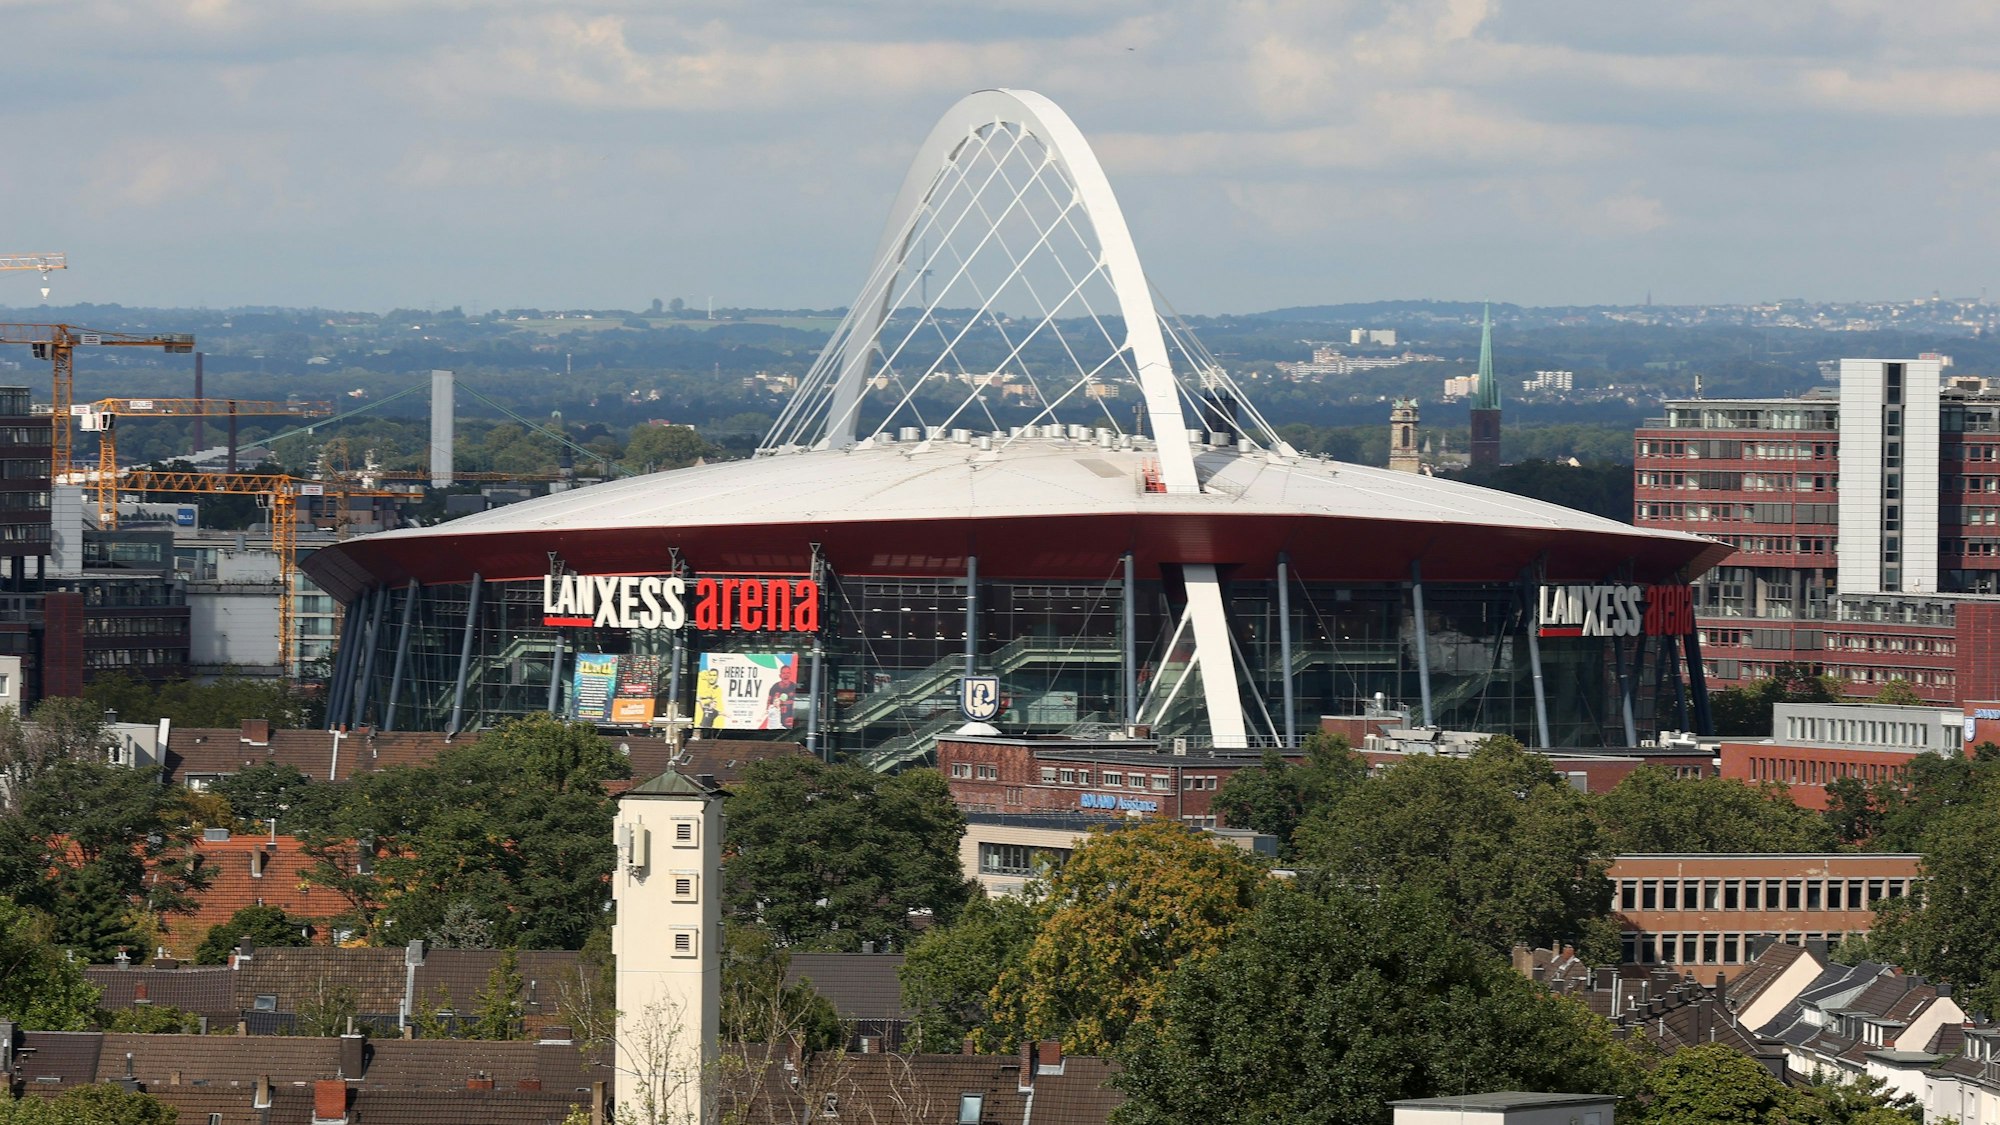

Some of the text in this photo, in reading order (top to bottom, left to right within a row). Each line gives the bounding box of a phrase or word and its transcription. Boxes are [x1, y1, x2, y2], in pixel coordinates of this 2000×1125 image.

[544, 575, 818, 632] LANXESS arena
[1539, 585, 1693, 637] LANXESS arena
[724, 666, 759, 678] HERE TO
[729, 679, 762, 698] PLAY
[1080, 793, 1158, 812] ROLAND Assistance
